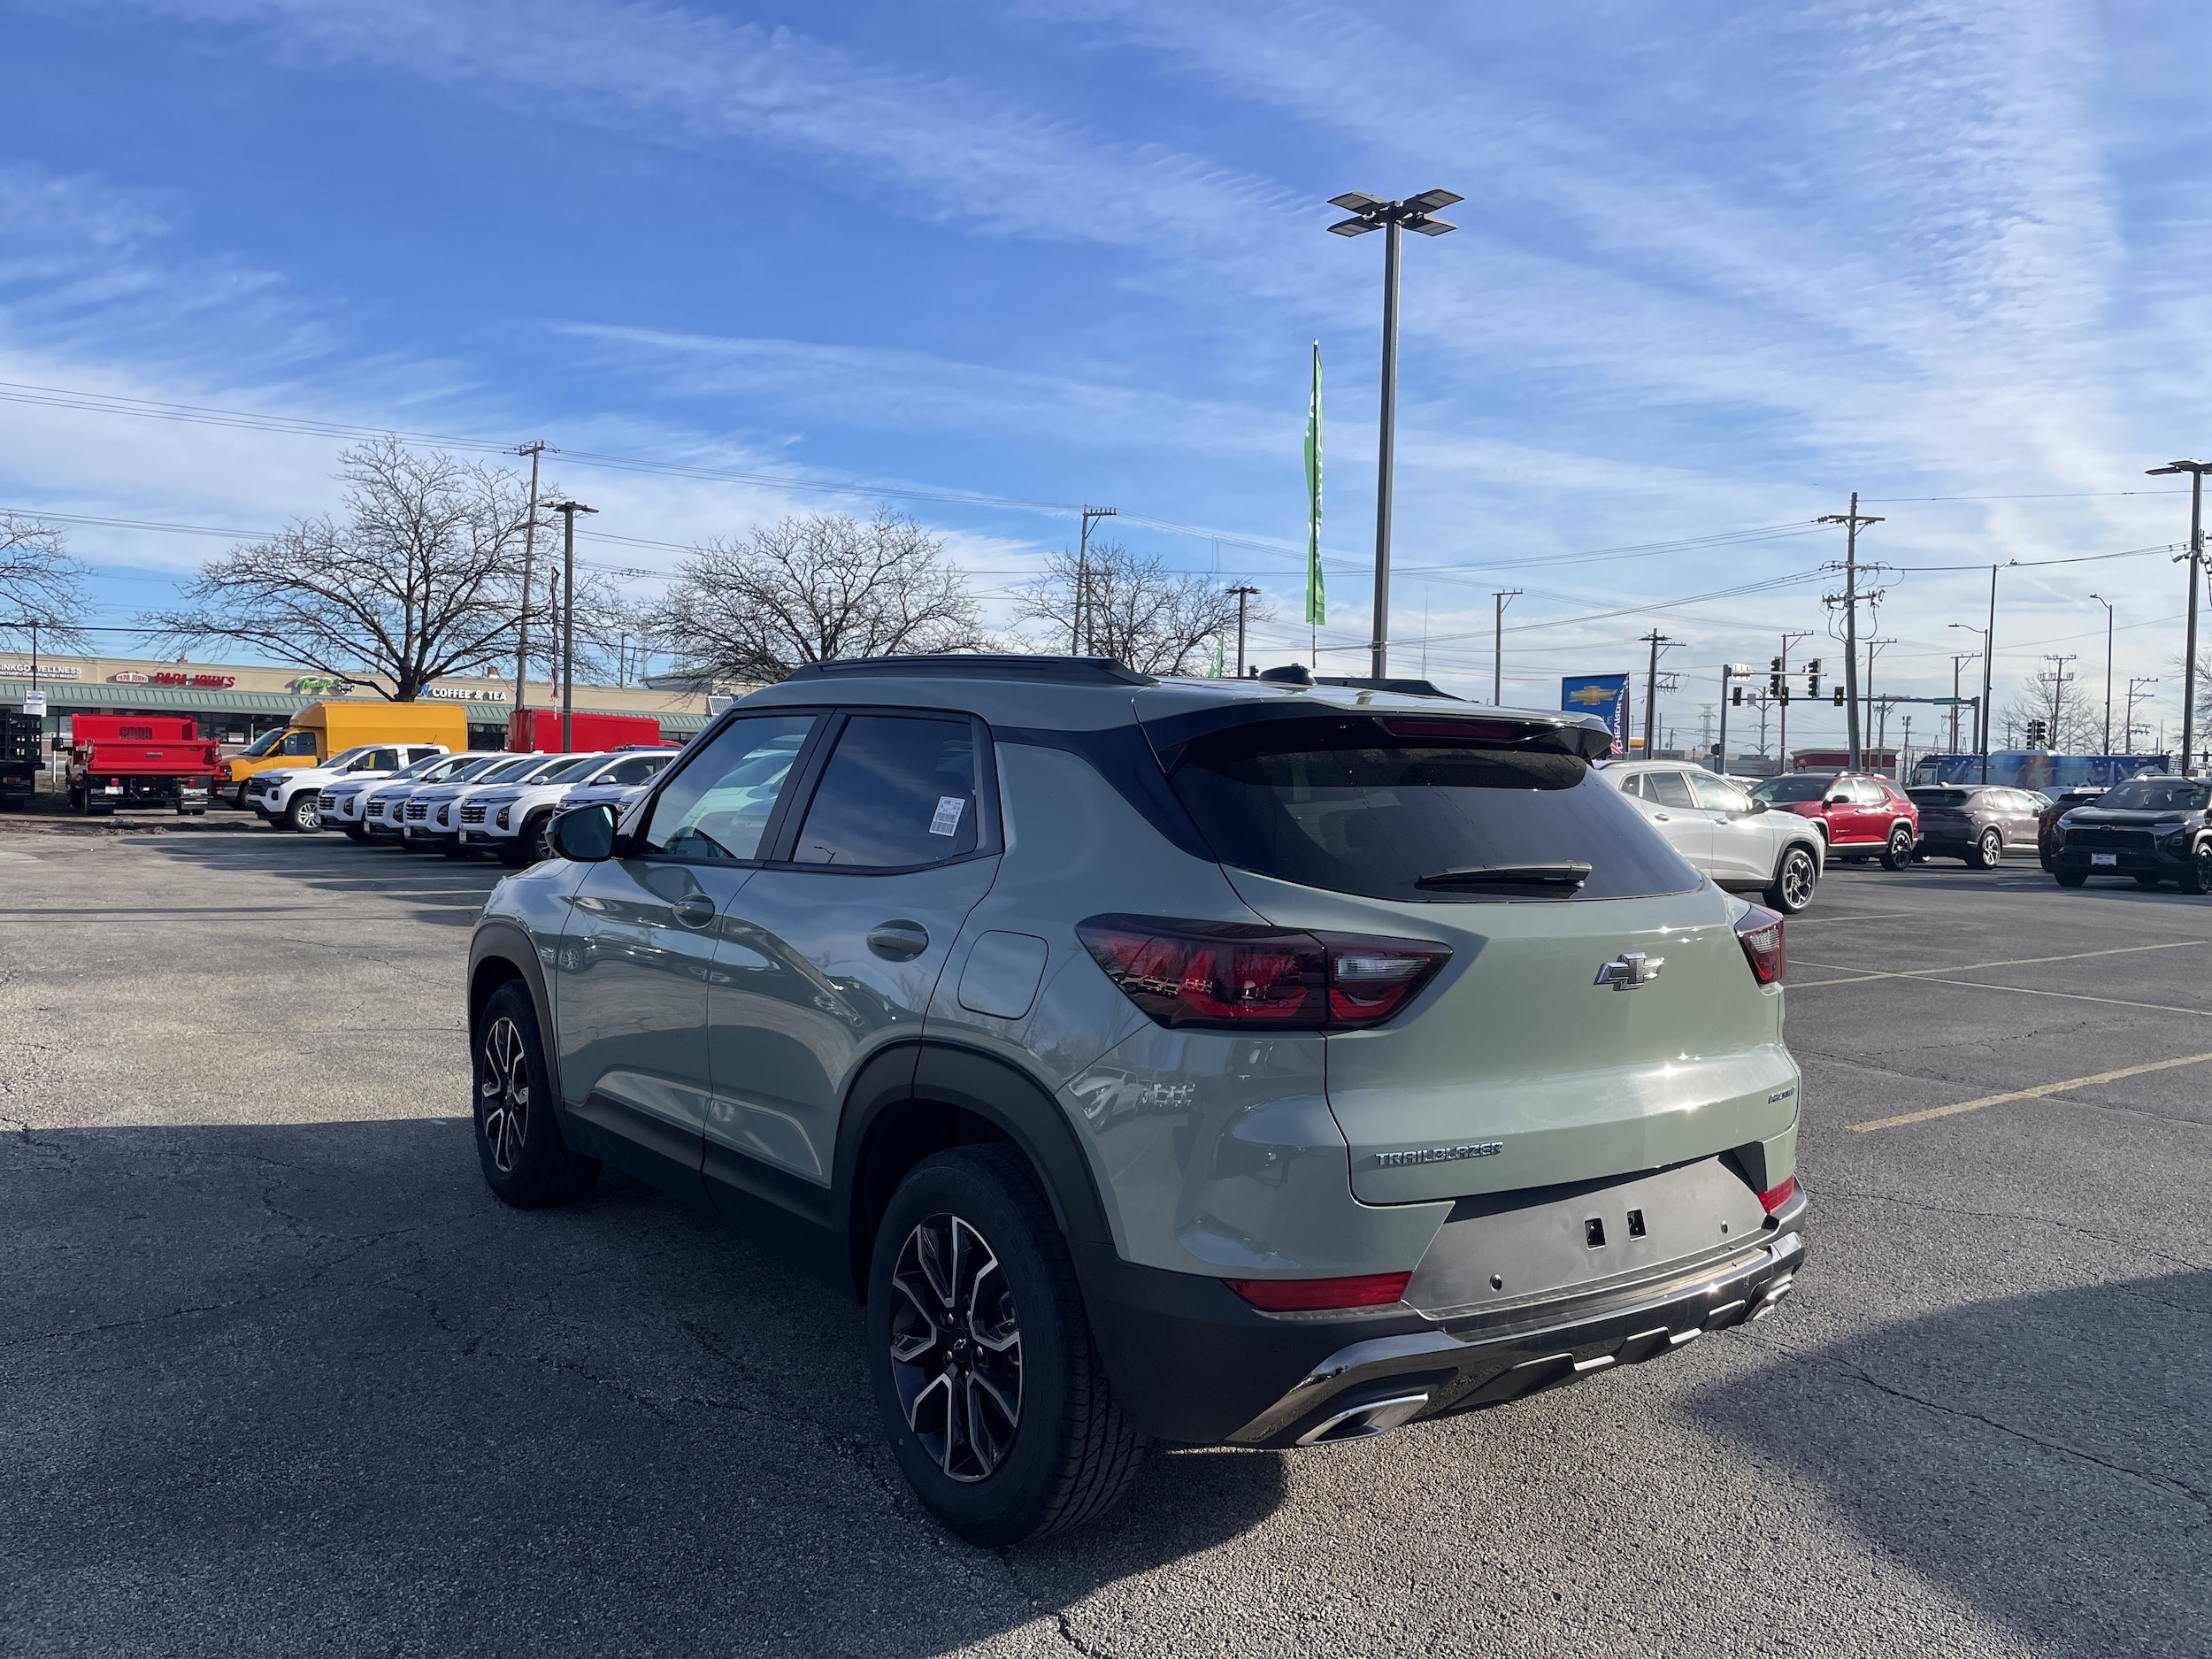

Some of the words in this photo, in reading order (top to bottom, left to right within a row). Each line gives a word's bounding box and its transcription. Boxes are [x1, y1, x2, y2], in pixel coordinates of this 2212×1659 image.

[154, 672, 188, 685] PAPA
[432, 687, 471, 699] COFFEE
[474, 690, 483, 699] &
[488, 691, 507, 700] TEA
[1375, 1141, 1503, 1166] TRAILBLAZER
